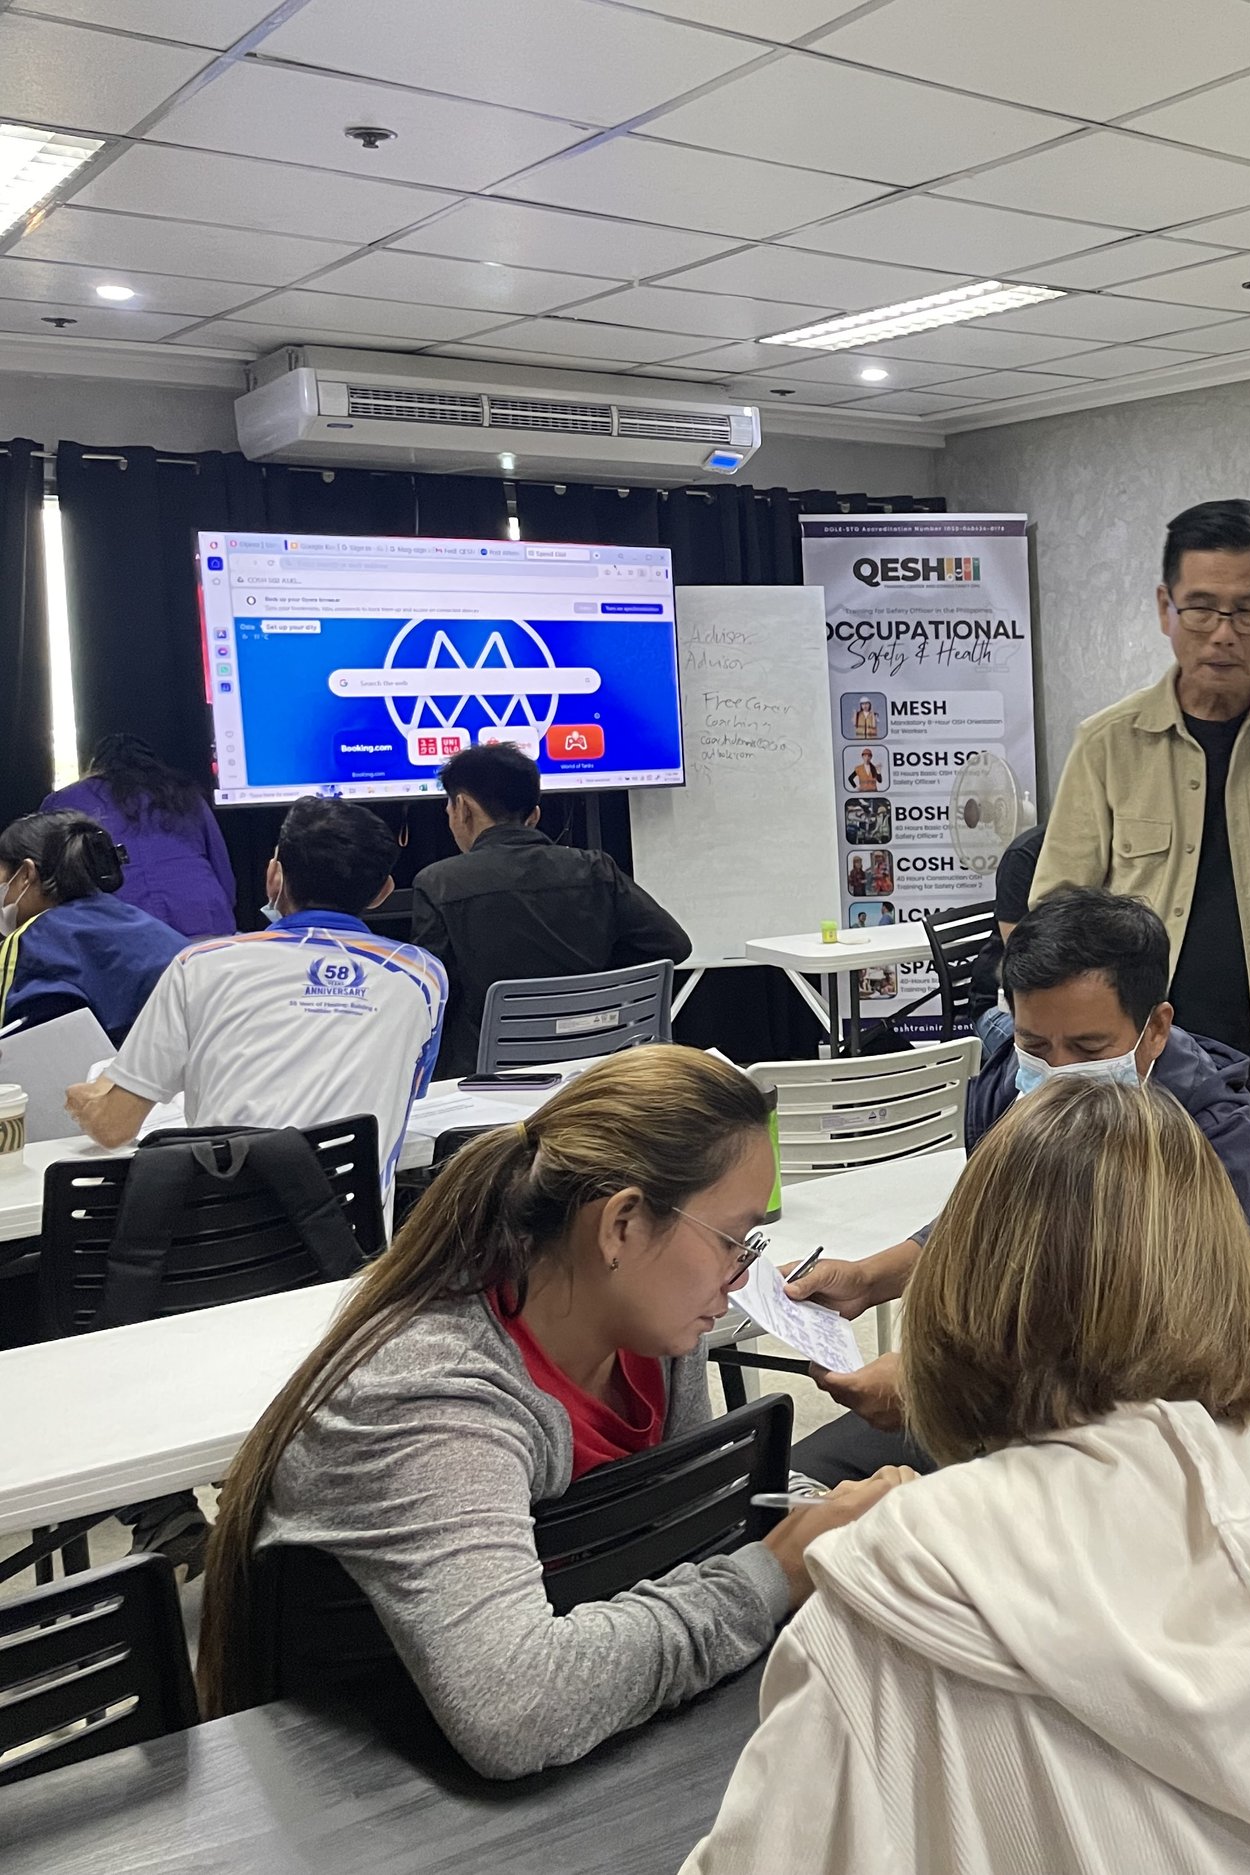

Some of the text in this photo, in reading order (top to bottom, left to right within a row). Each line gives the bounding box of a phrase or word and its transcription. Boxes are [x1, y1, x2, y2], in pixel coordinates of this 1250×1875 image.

[848, 637, 909, 676] Safety
[936, 635, 991, 666] Health
[890, 700, 947, 716] MESH
[341, 744, 392, 753] Booking.com
[892, 751, 948, 767] BOSH
[895, 806, 949, 821] BOSH
[896, 857, 954, 872] COSH
[324, 965, 350, 981] 58
[304, 986, 367, 997] ANNIVERSARY
